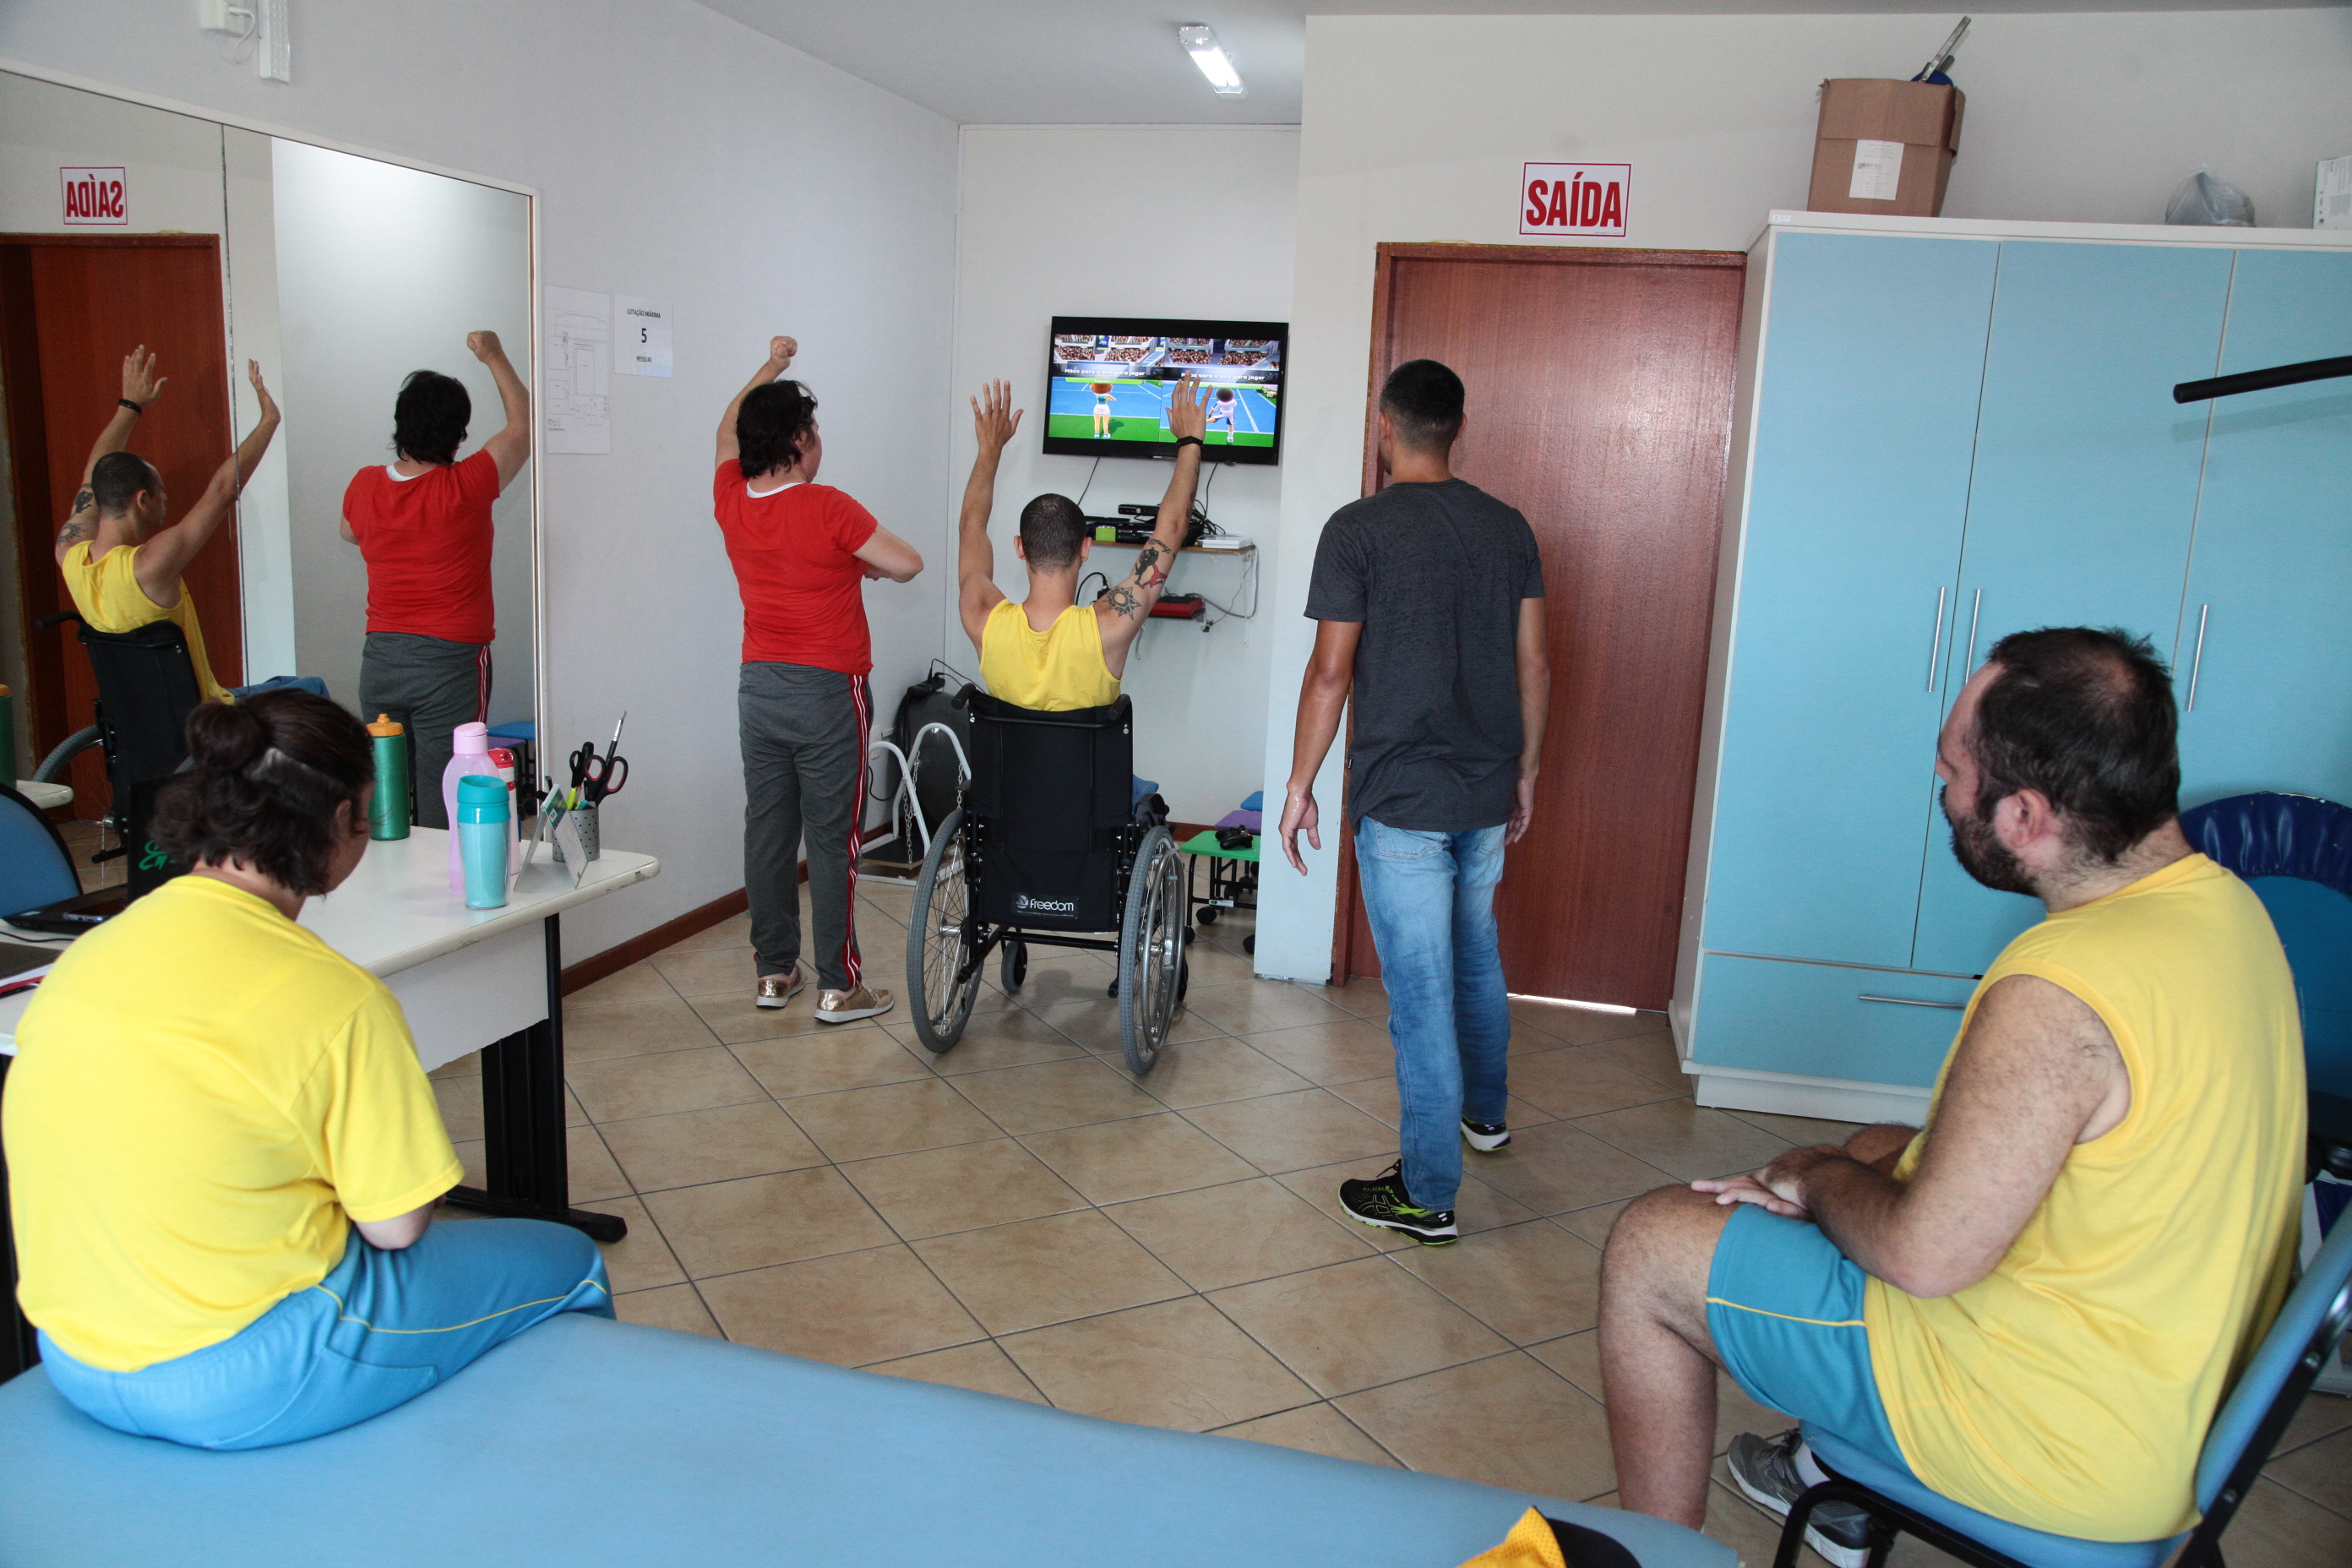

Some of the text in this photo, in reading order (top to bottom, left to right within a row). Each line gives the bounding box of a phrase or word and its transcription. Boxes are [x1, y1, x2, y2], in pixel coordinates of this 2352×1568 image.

[1526, 172, 1622, 227] SAÍDA
[627, 308, 662, 318] LOTAÇÃO MÁXIMA
[641, 327, 647, 343] 5
